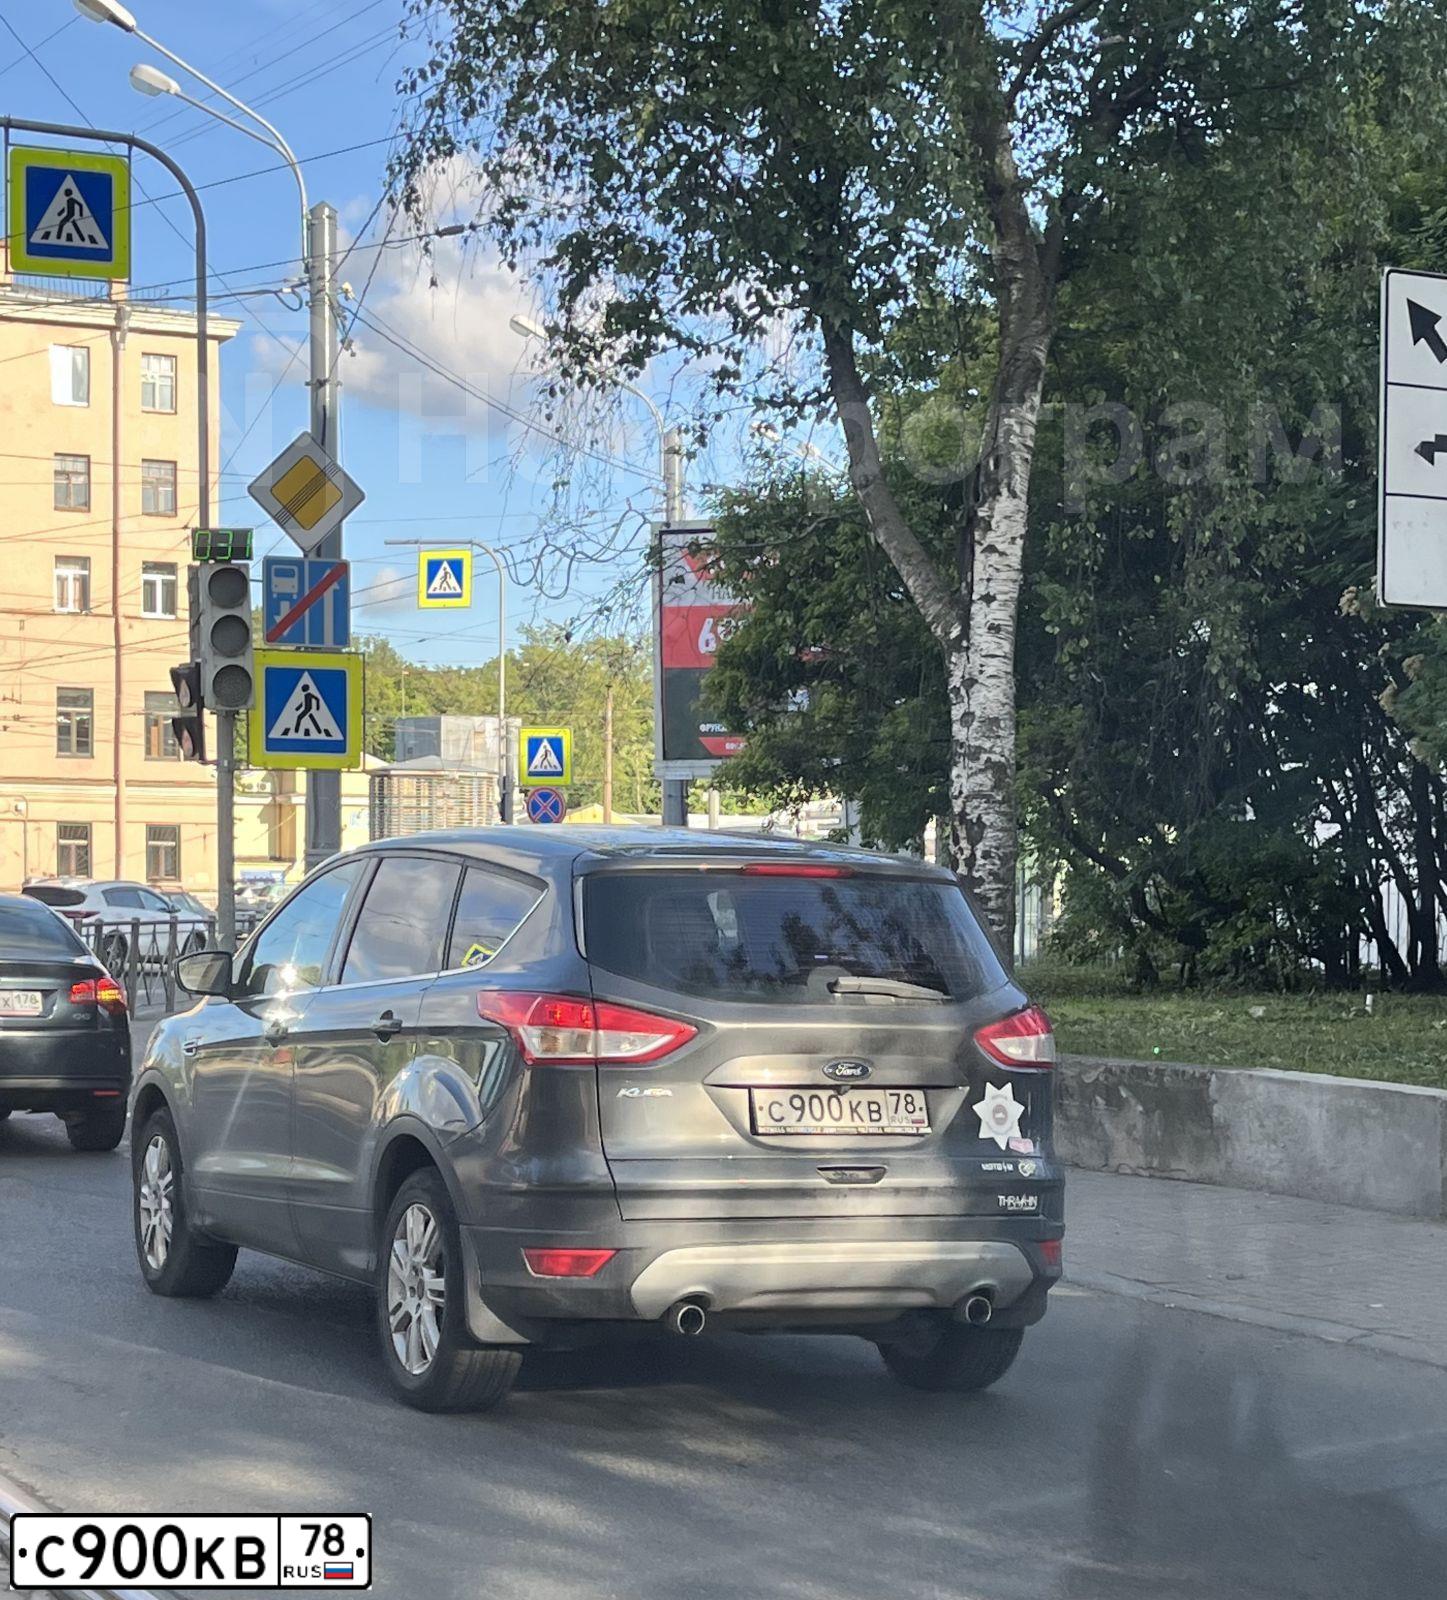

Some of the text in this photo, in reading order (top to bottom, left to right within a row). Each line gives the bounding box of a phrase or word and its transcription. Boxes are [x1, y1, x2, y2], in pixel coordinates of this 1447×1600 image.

[194, 530, 253, 560] 031
[835, 1063, 863, 1076] Ford
[768, 1093, 916, 1123] С900КВ 78
